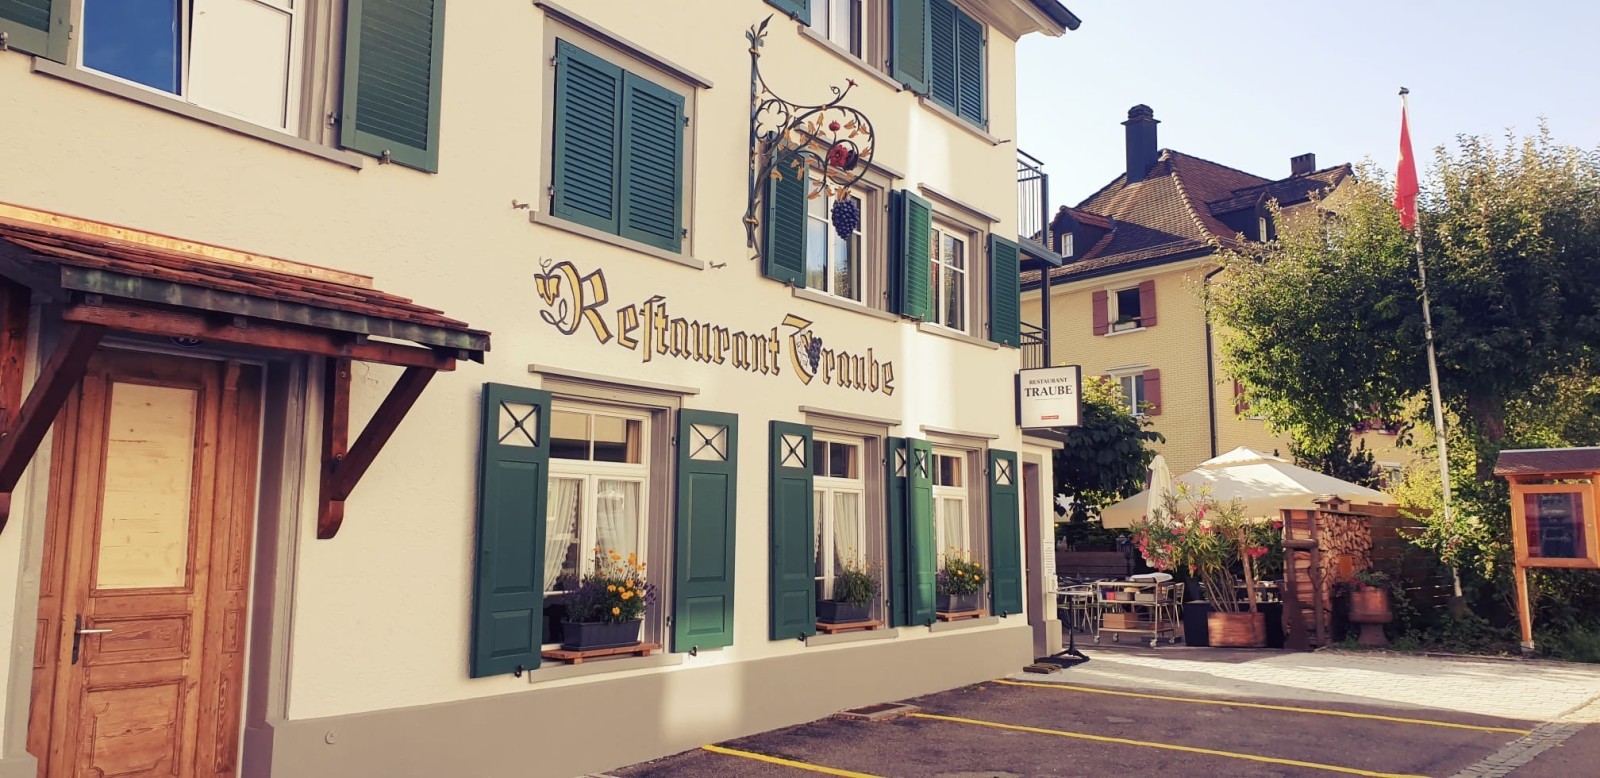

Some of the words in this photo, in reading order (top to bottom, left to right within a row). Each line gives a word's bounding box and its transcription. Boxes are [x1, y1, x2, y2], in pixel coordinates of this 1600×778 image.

[781, 313, 895, 396] Traube
[1029, 377, 1068, 385] RESTAURANT
[1024, 385, 1073, 397] TRAUBE
